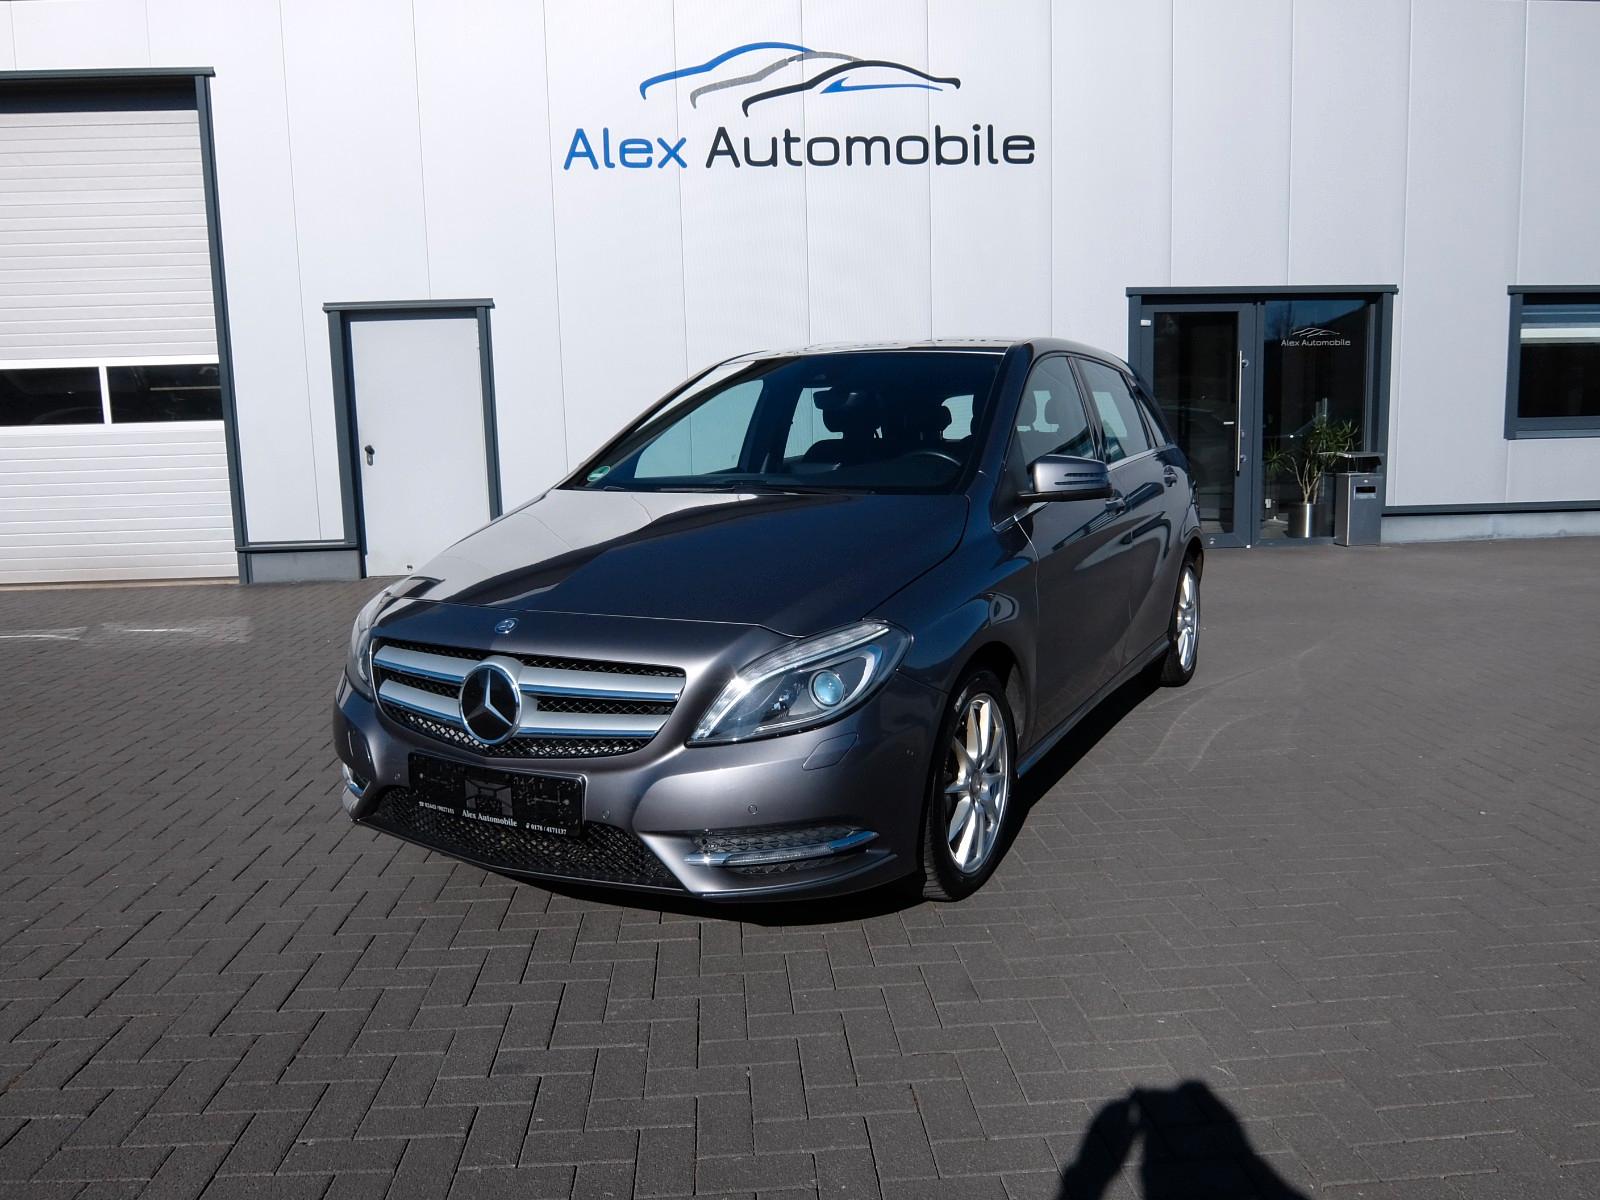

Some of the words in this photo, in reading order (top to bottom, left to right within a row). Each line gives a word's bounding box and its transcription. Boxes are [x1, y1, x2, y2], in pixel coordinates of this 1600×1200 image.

[564, 127, 687, 170] Alex
[706, 123, 1035, 168] Automobile
[1281, 339, 1299, 347] Alex
[1301, 338, 1351, 346] Automobile
[462, 809, 477, 820] Alex
[477, 811, 518, 827] Automobile
